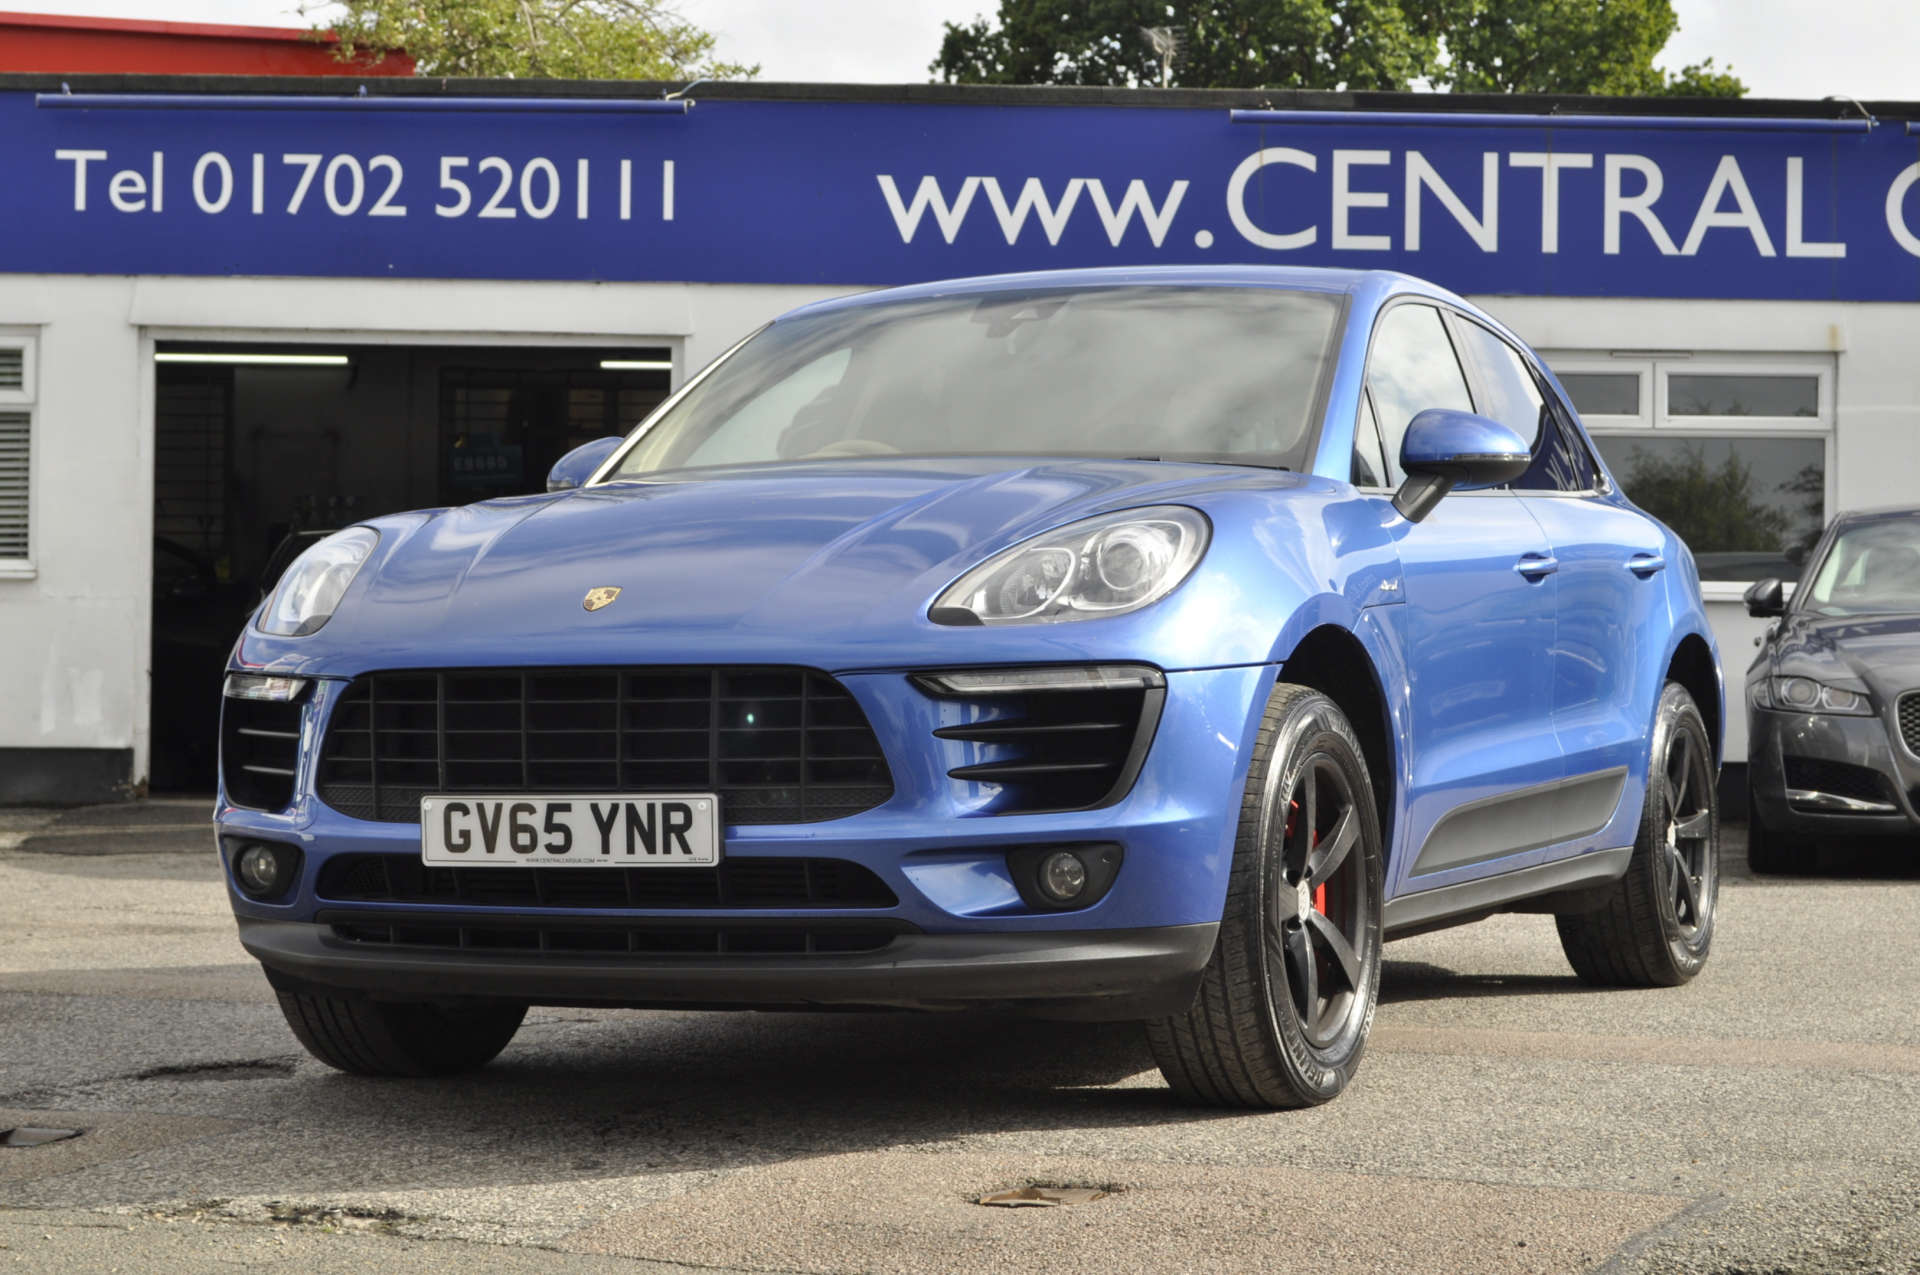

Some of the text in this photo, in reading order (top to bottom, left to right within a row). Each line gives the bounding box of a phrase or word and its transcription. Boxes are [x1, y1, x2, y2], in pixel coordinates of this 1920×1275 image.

[55, 150, 675, 221] Tel 01702 520111
[443, 802, 693, 855] GV65 YNR
